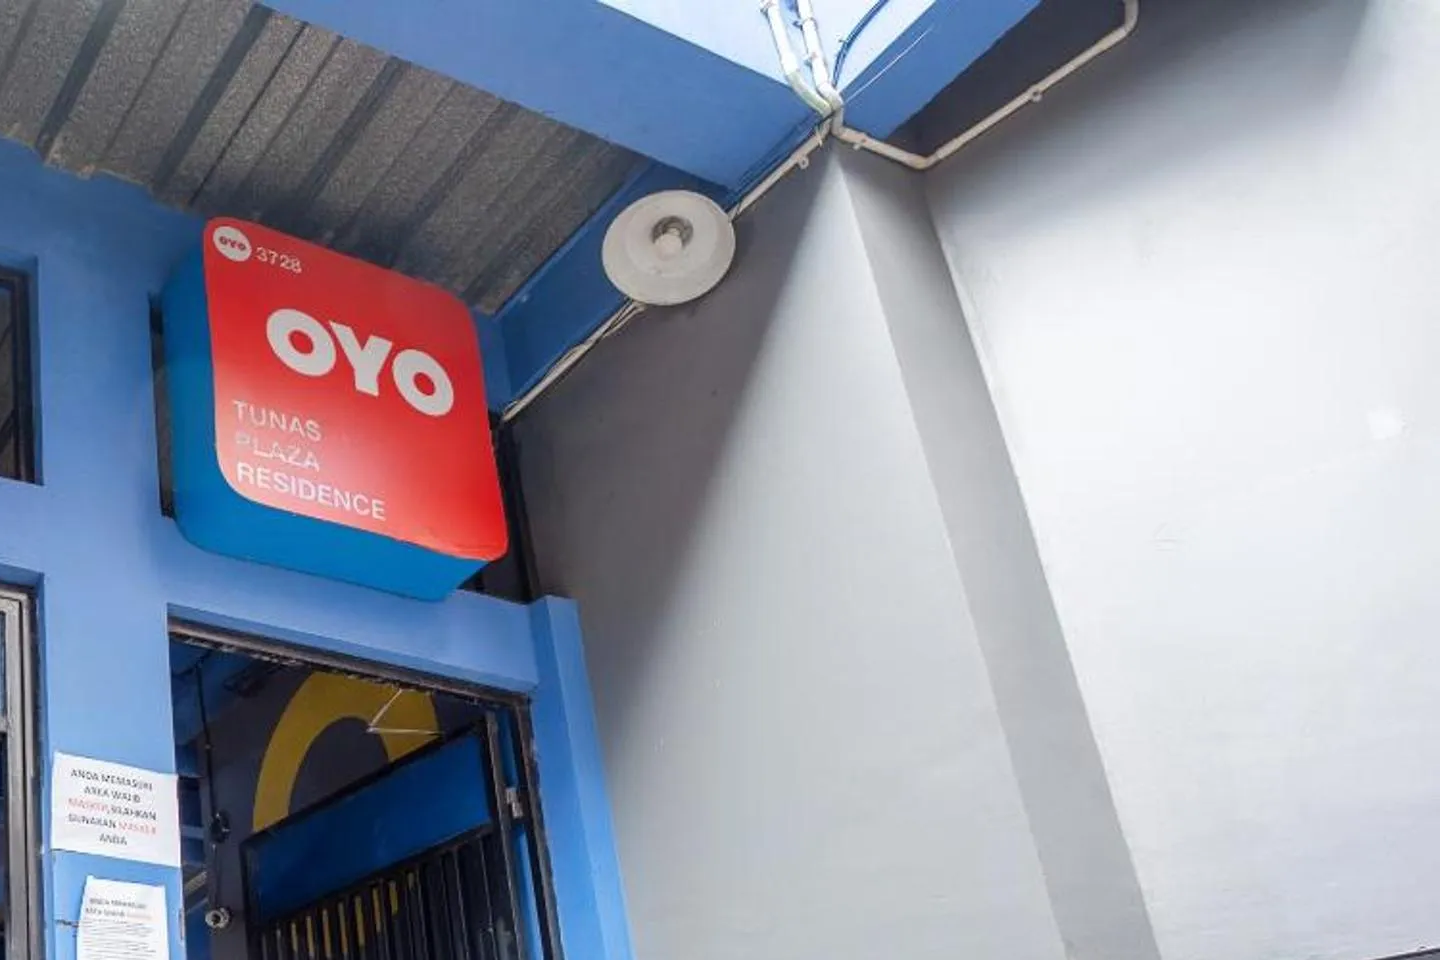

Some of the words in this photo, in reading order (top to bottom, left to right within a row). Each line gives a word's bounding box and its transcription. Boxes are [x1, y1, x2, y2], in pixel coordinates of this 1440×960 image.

[219, 236, 247, 251] OYO
[255, 246, 302, 274] 3728
[266, 308, 454, 416] OYO
[234, 400, 322, 442] TUNAS
[235, 430, 320, 472] PLAZA
[237, 461, 387, 522] RESIDENCE
[70, 768, 99, 781] ANDA
